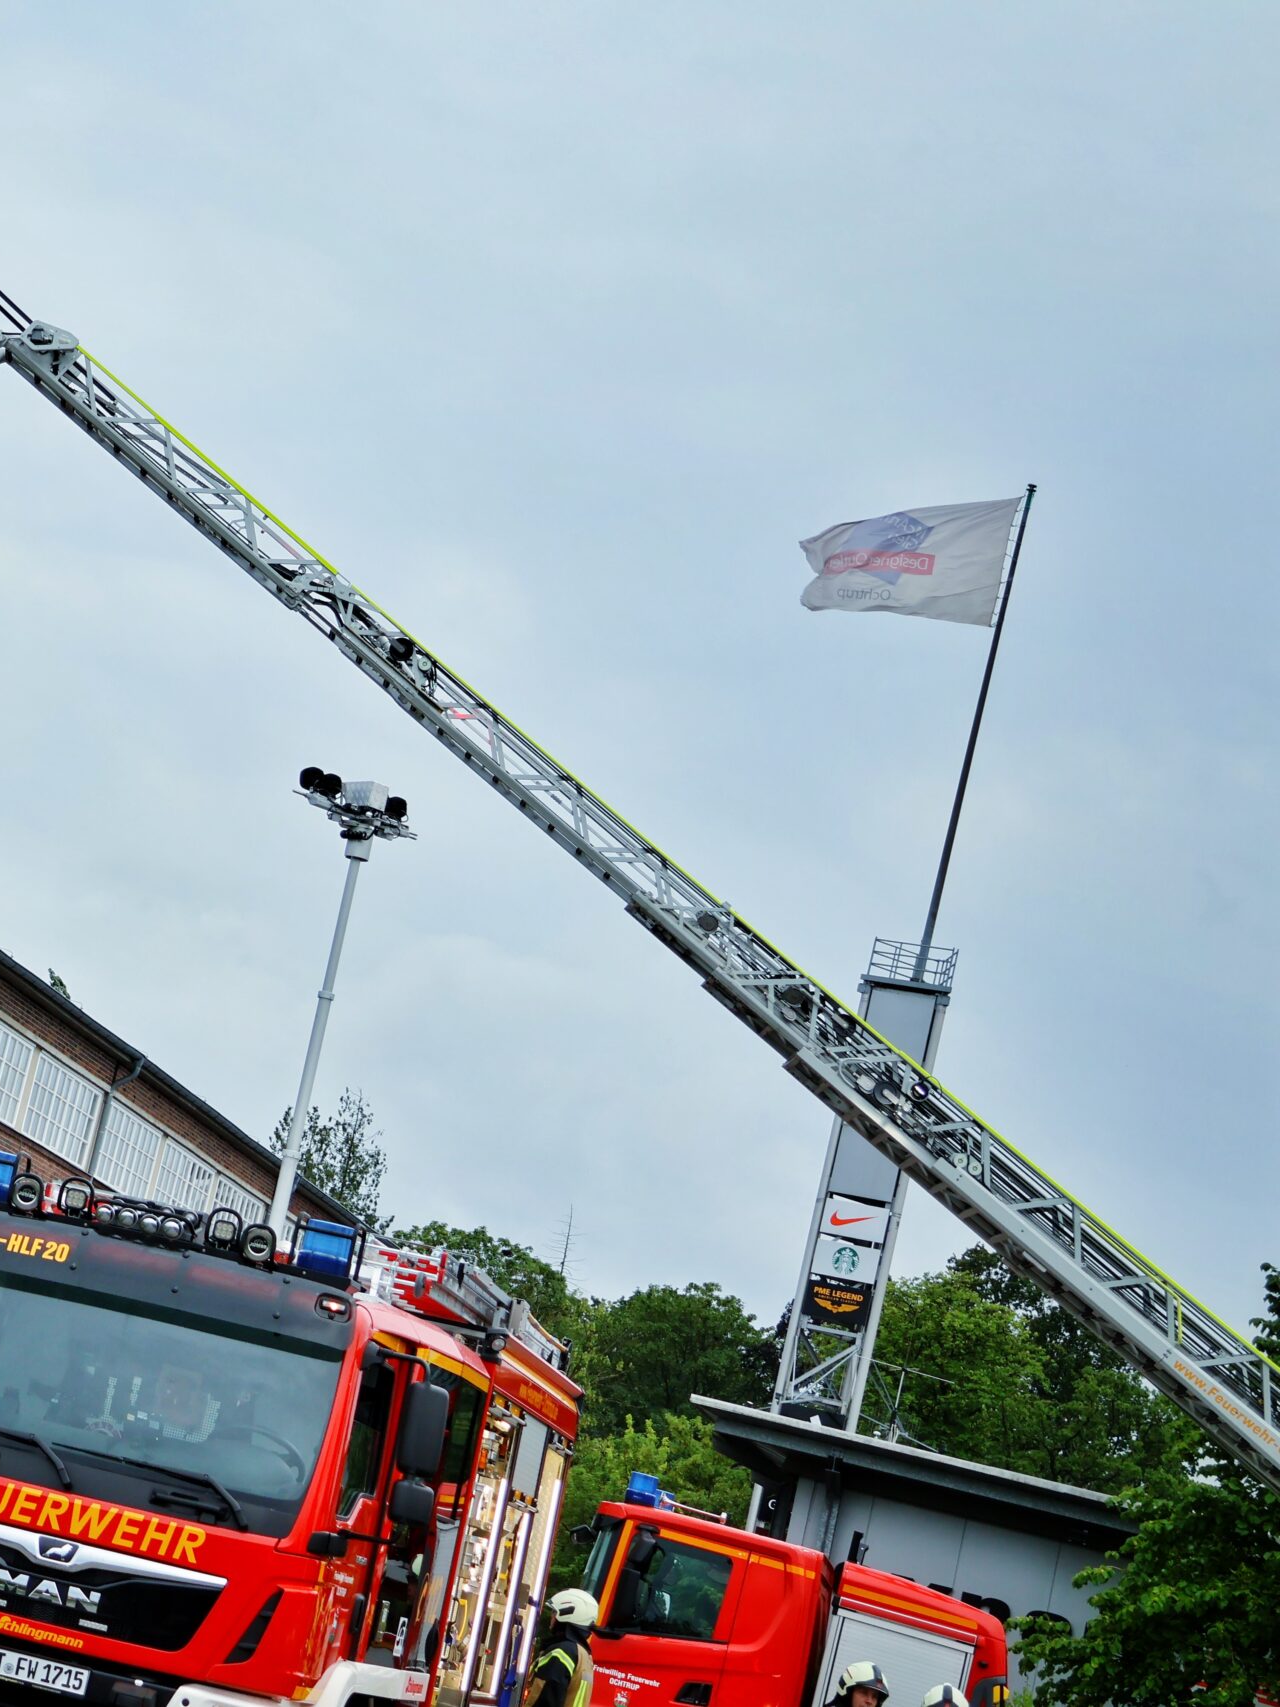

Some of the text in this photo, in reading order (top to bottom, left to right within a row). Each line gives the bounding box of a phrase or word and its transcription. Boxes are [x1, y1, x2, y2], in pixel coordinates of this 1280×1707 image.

[41, 1241, 70, 1262] 20
[814, 1286, 864, 1302] PME LEGEND
[1173, 1360, 1280, 1453] www.Feuerwehr-
[15, 1657, 39, 1680] FW
[40, 1664, 84, 1690] 1715
[627, 1673, 660, 1688] Feuerwehr
[609, 1677, 640, 1691] OCHTRUP
